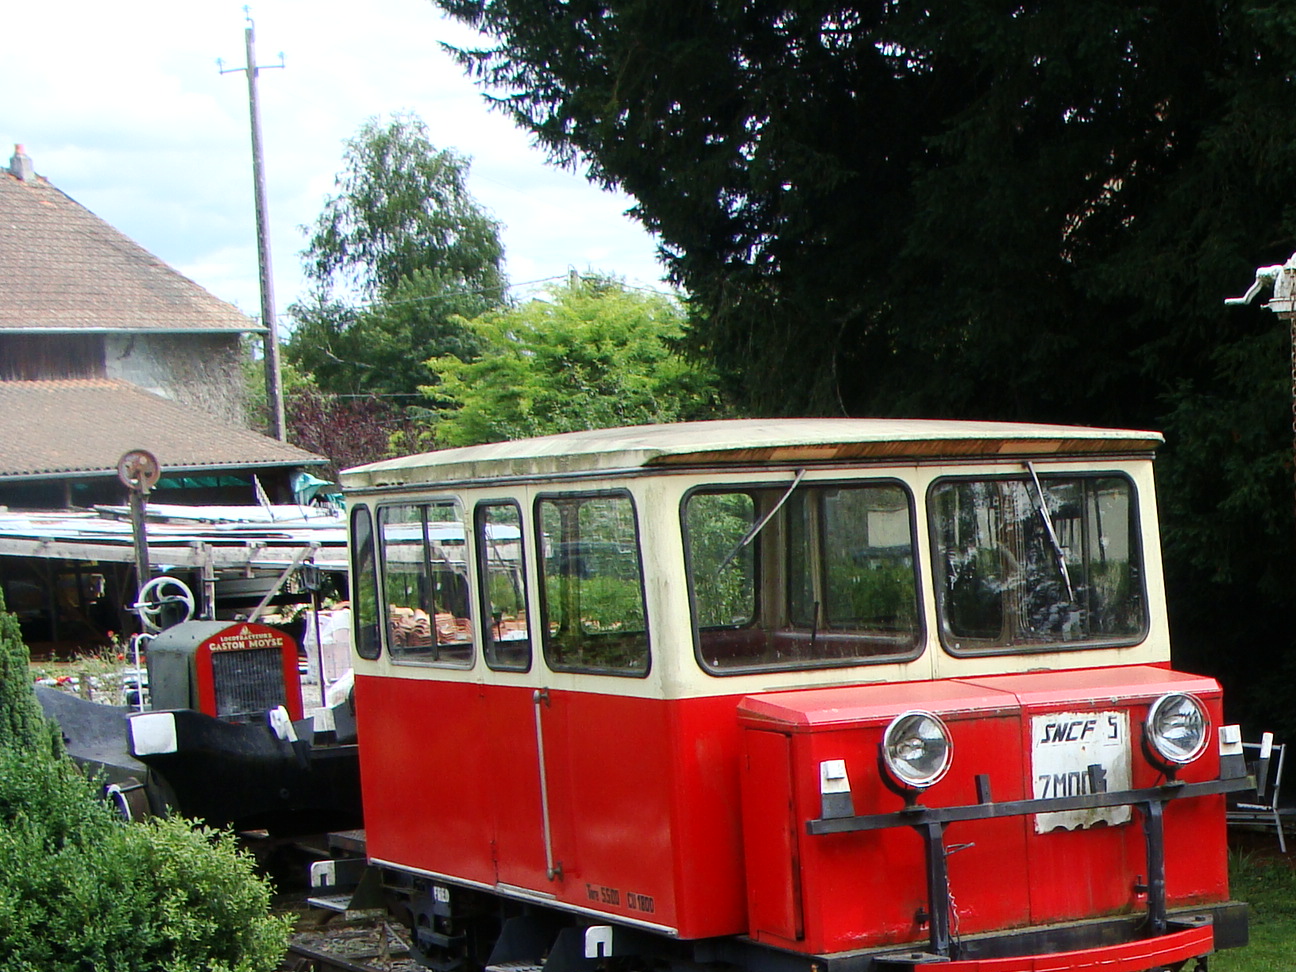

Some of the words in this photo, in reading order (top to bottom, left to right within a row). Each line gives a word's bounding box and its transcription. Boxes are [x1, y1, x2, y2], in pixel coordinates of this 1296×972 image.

[209, 640, 245, 651] GASTON
[249, 637, 283, 649] MOYSE
[1041, 720, 1097, 744] SNCF
